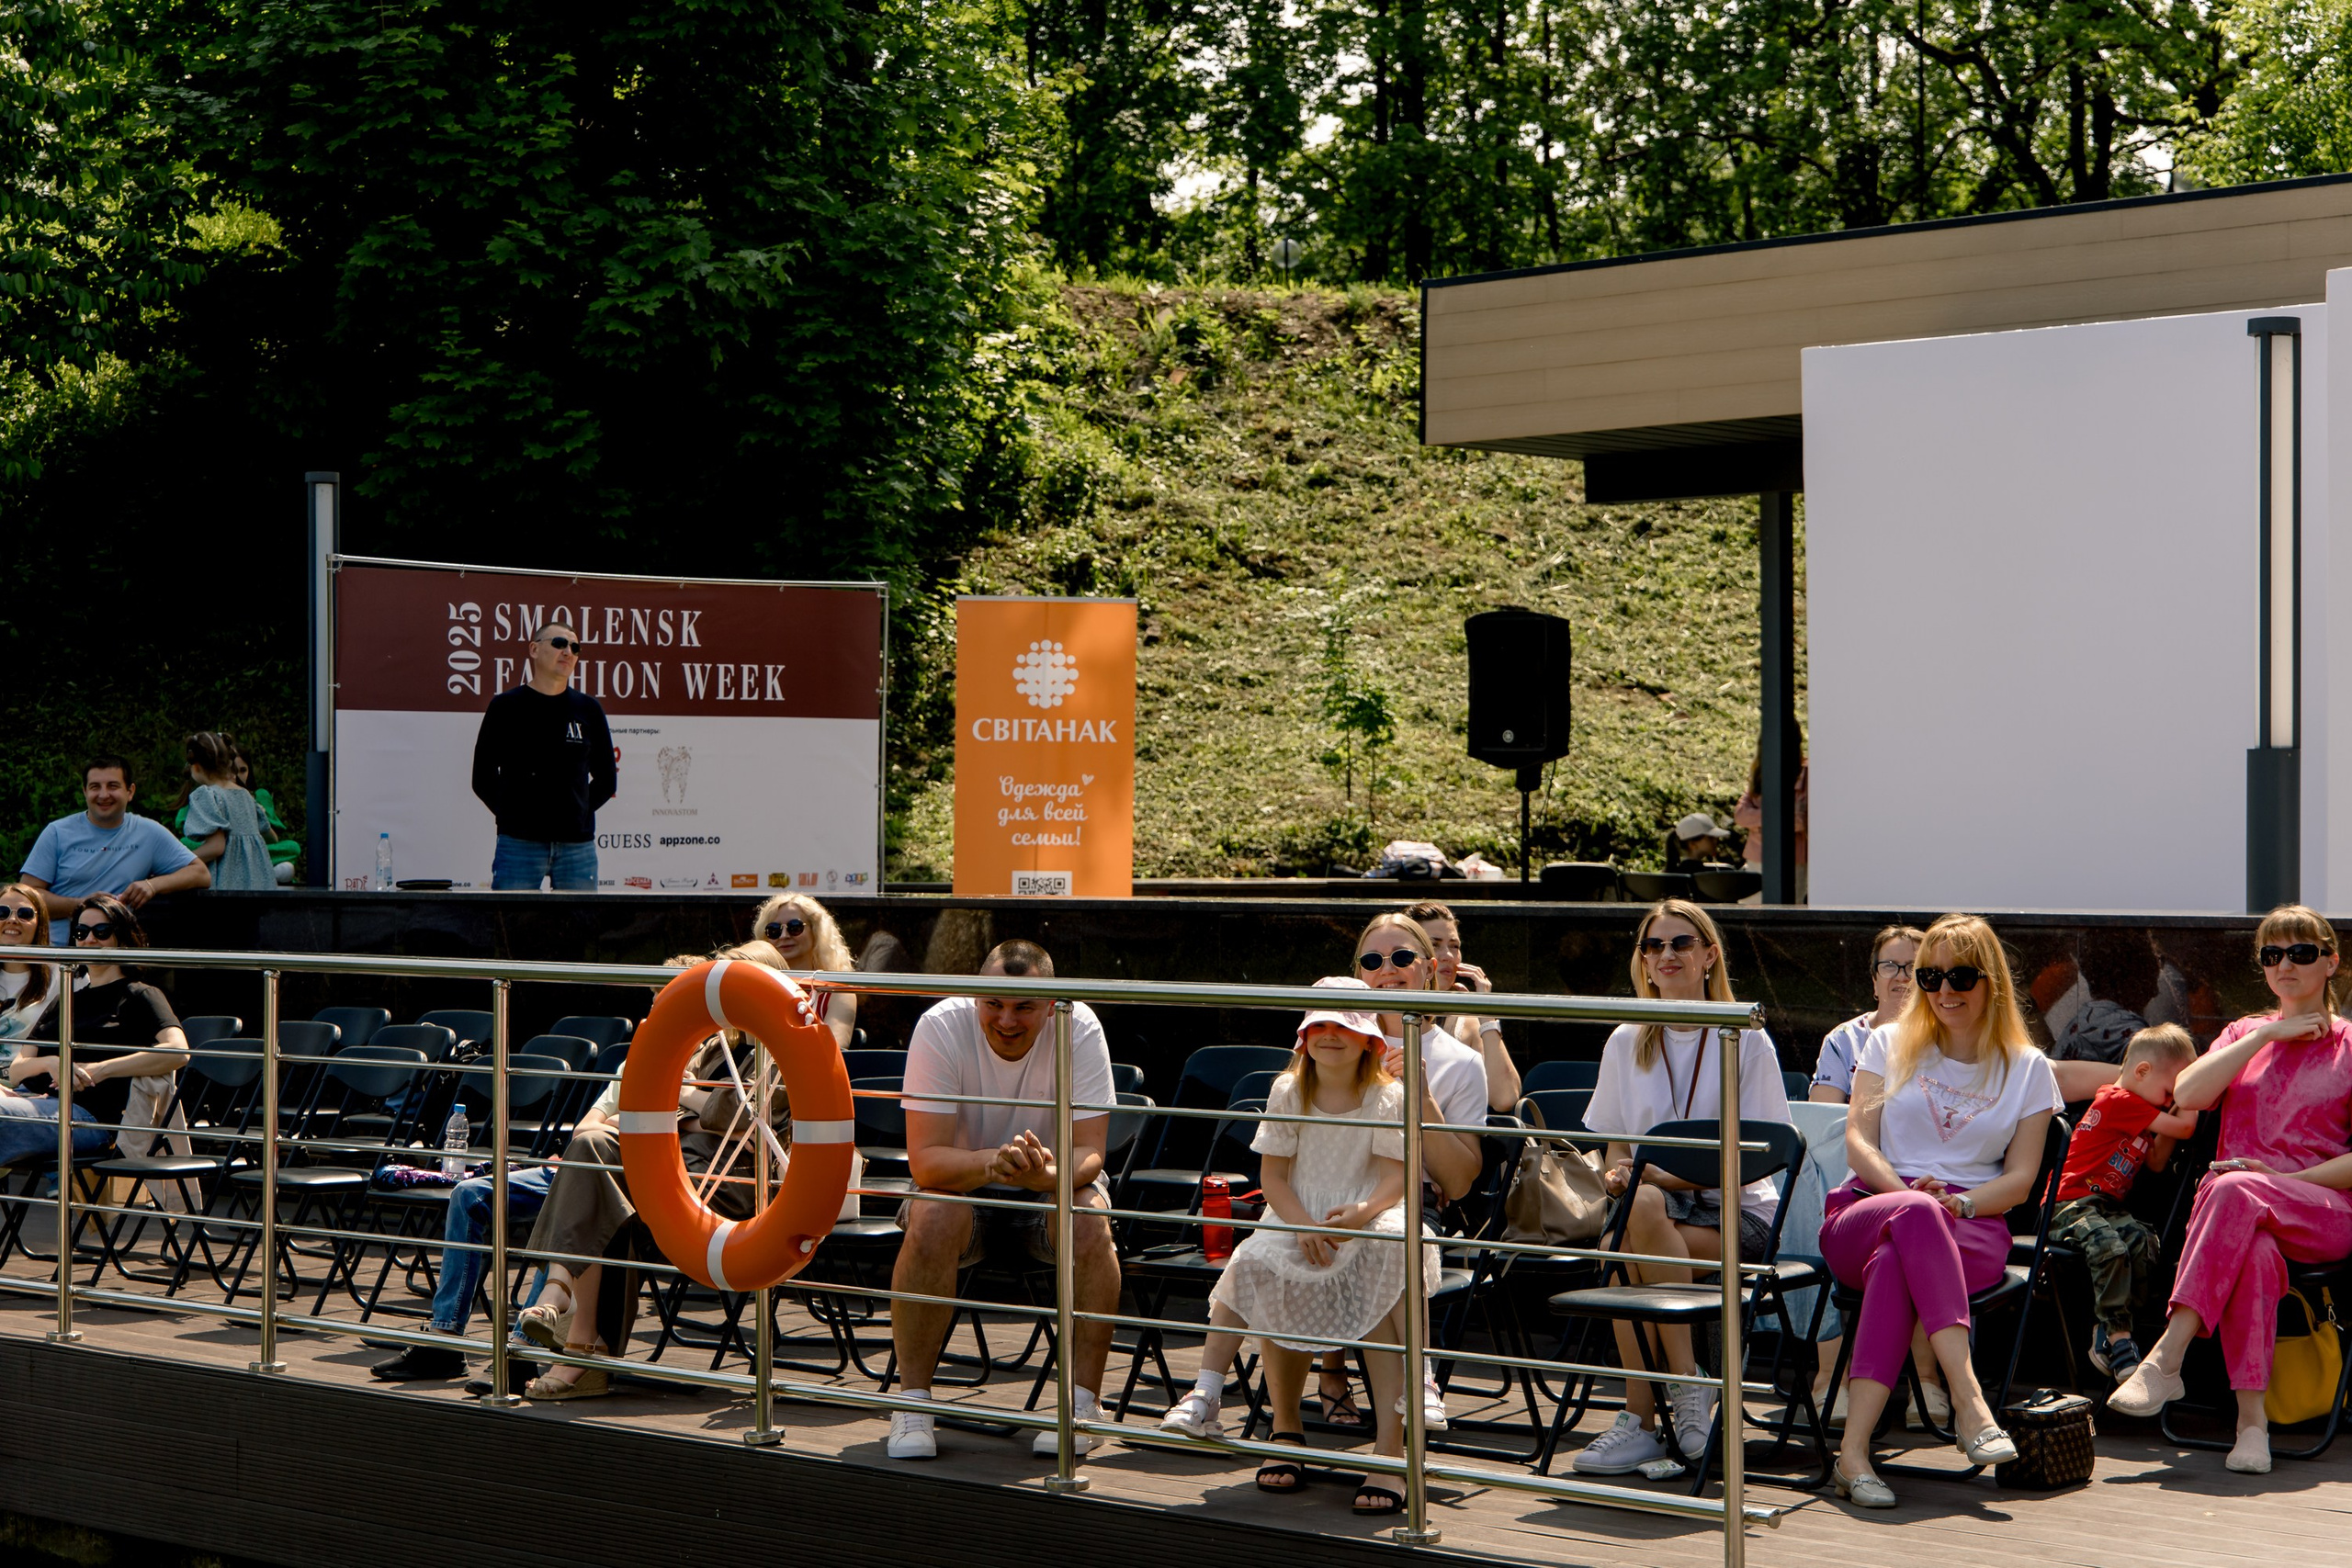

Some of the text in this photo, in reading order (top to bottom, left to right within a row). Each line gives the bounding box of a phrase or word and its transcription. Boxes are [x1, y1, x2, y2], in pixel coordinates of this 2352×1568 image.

[447, 602, 481, 695] 2025
[493, 658, 786, 701] FAHION WEEK
[972, 717, 1117, 743] СВІТАНАК
[999, 775, 1083, 803] Одежда
[998, 800, 1088, 827] для всей
[597, 833, 721, 849] GUESS appzone.co
[1012, 826, 1081, 846] семьи!
